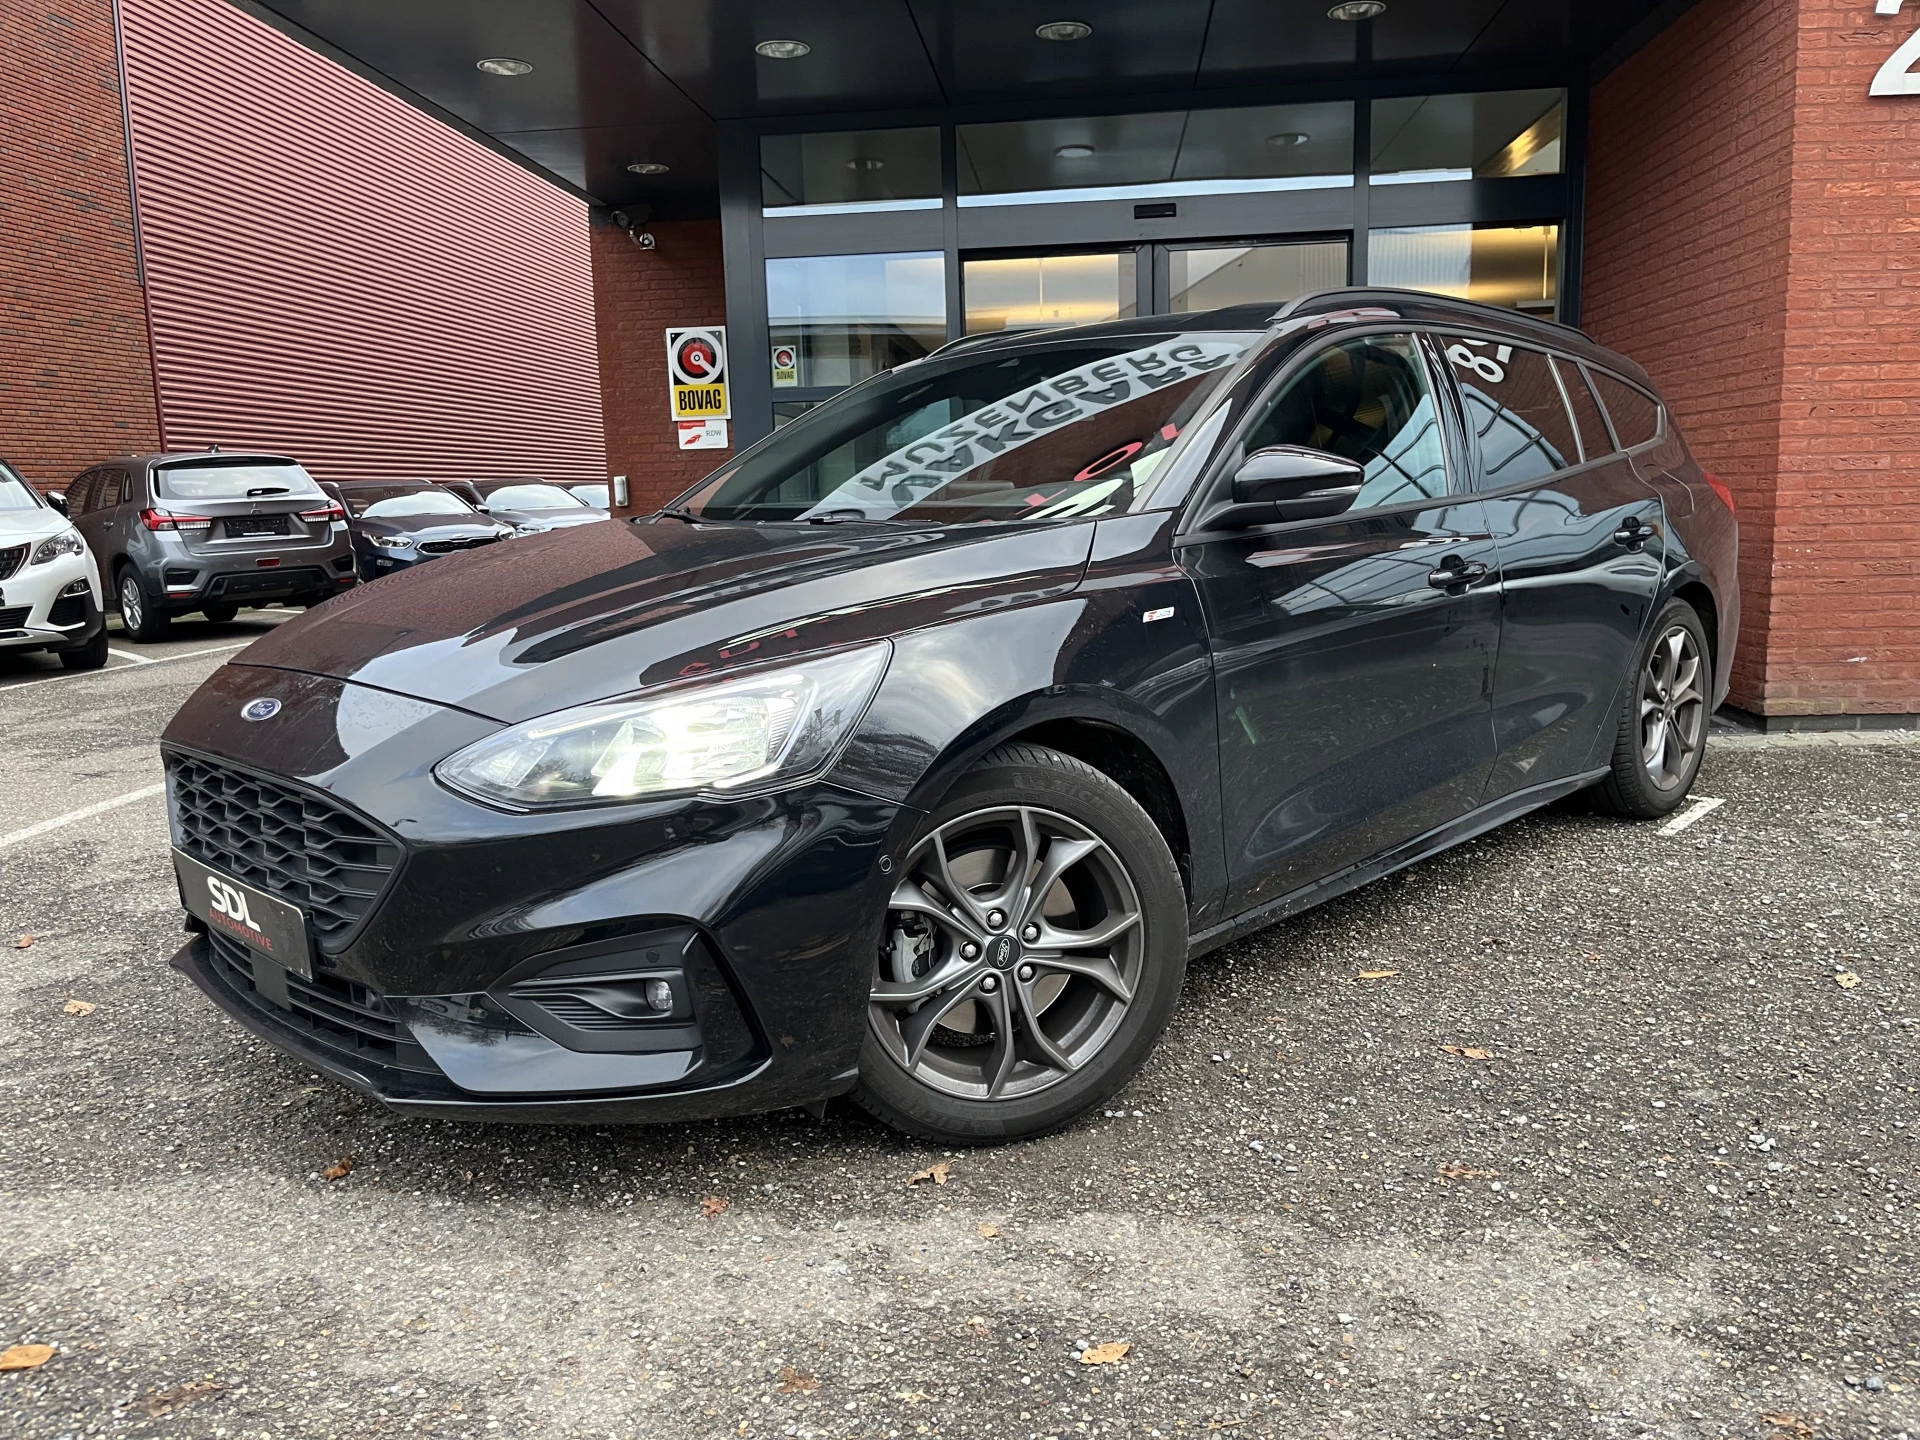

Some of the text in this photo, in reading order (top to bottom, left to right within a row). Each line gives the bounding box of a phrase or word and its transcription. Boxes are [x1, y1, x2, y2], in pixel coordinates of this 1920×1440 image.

[776, 370, 795, 380] BOVAG
[678, 388, 722, 411] BOVAG
[705, 429, 722, 437] RDW
[207, 875, 262, 933] SDL
[209, 907, 274, 951] AUTOMOTIVE
